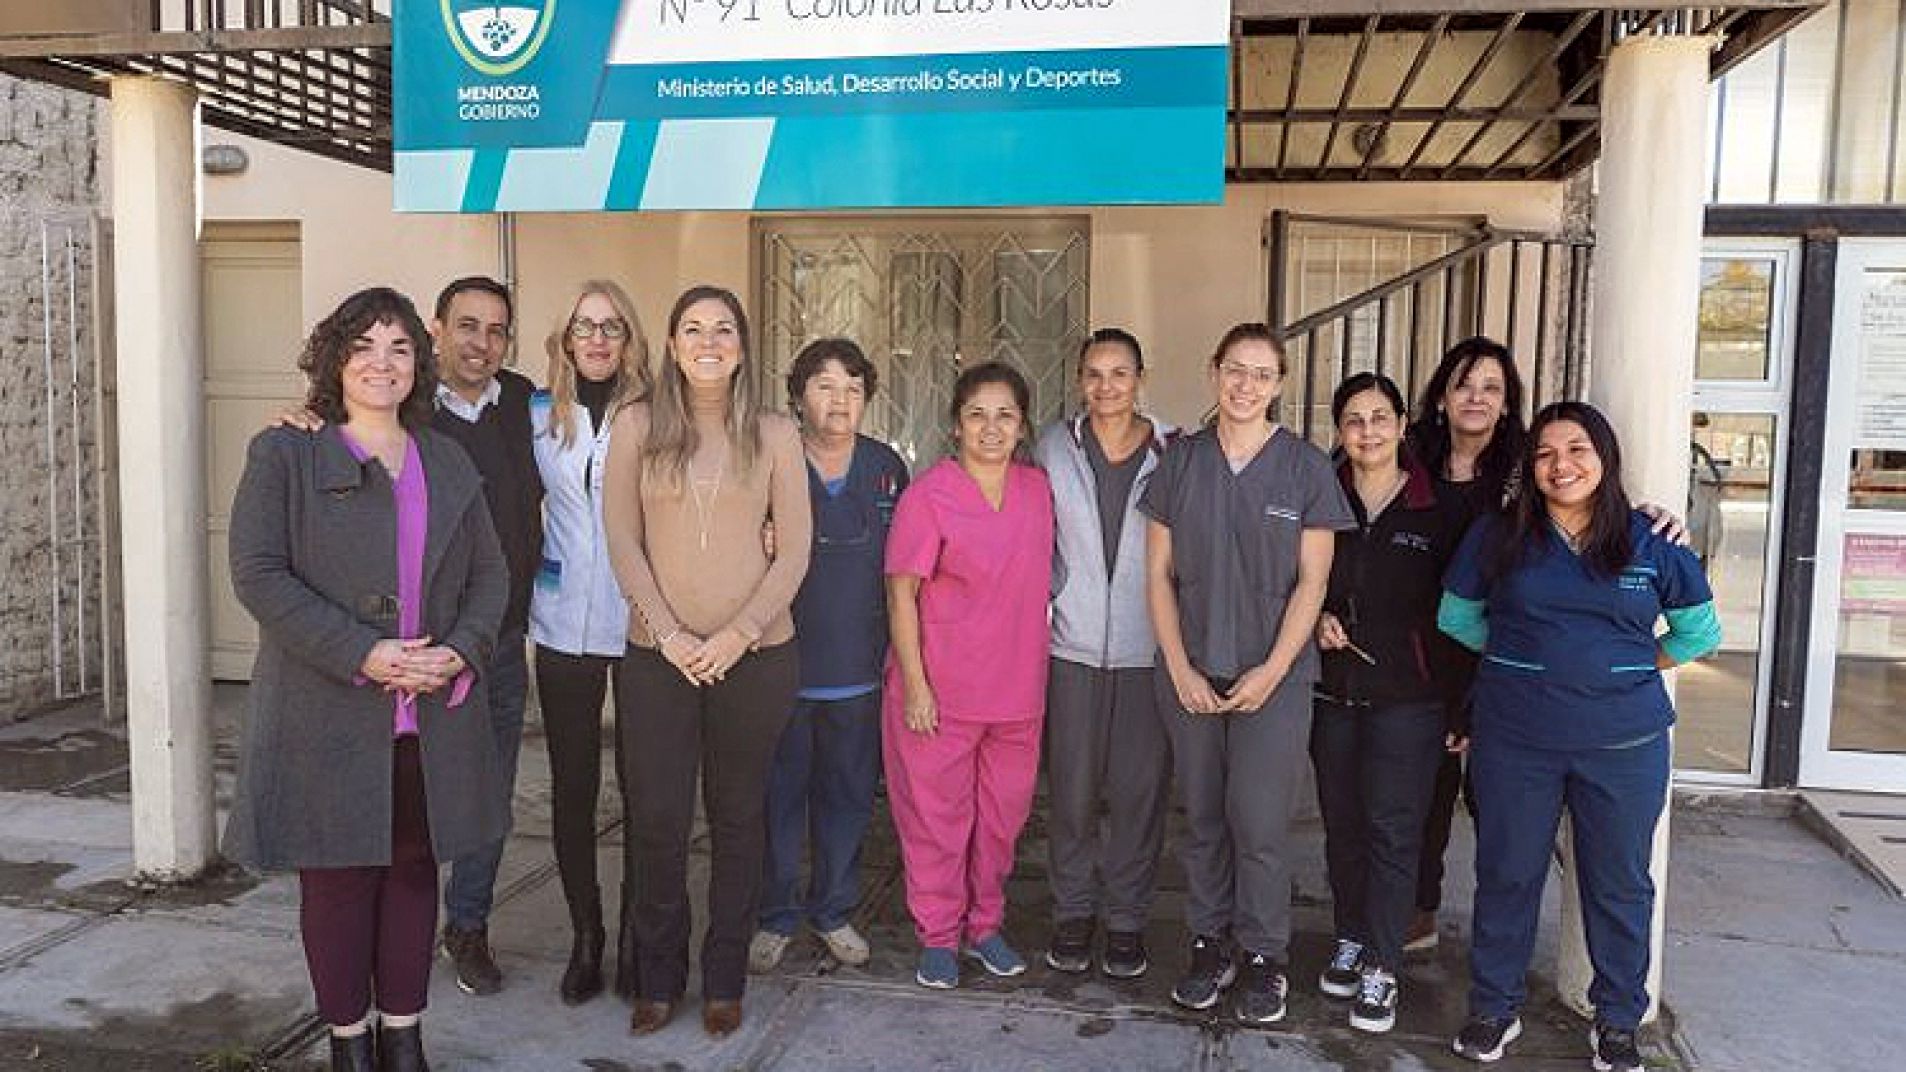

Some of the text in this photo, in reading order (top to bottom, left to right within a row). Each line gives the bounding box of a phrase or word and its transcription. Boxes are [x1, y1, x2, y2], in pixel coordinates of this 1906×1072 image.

[657, 65, 1122, 98] Ministerio de Salud, Desarrollo Social y Deportes
[457, 84, 540, 101] MENDOZA
[459, 102, 540, 120] GOBIERNO
